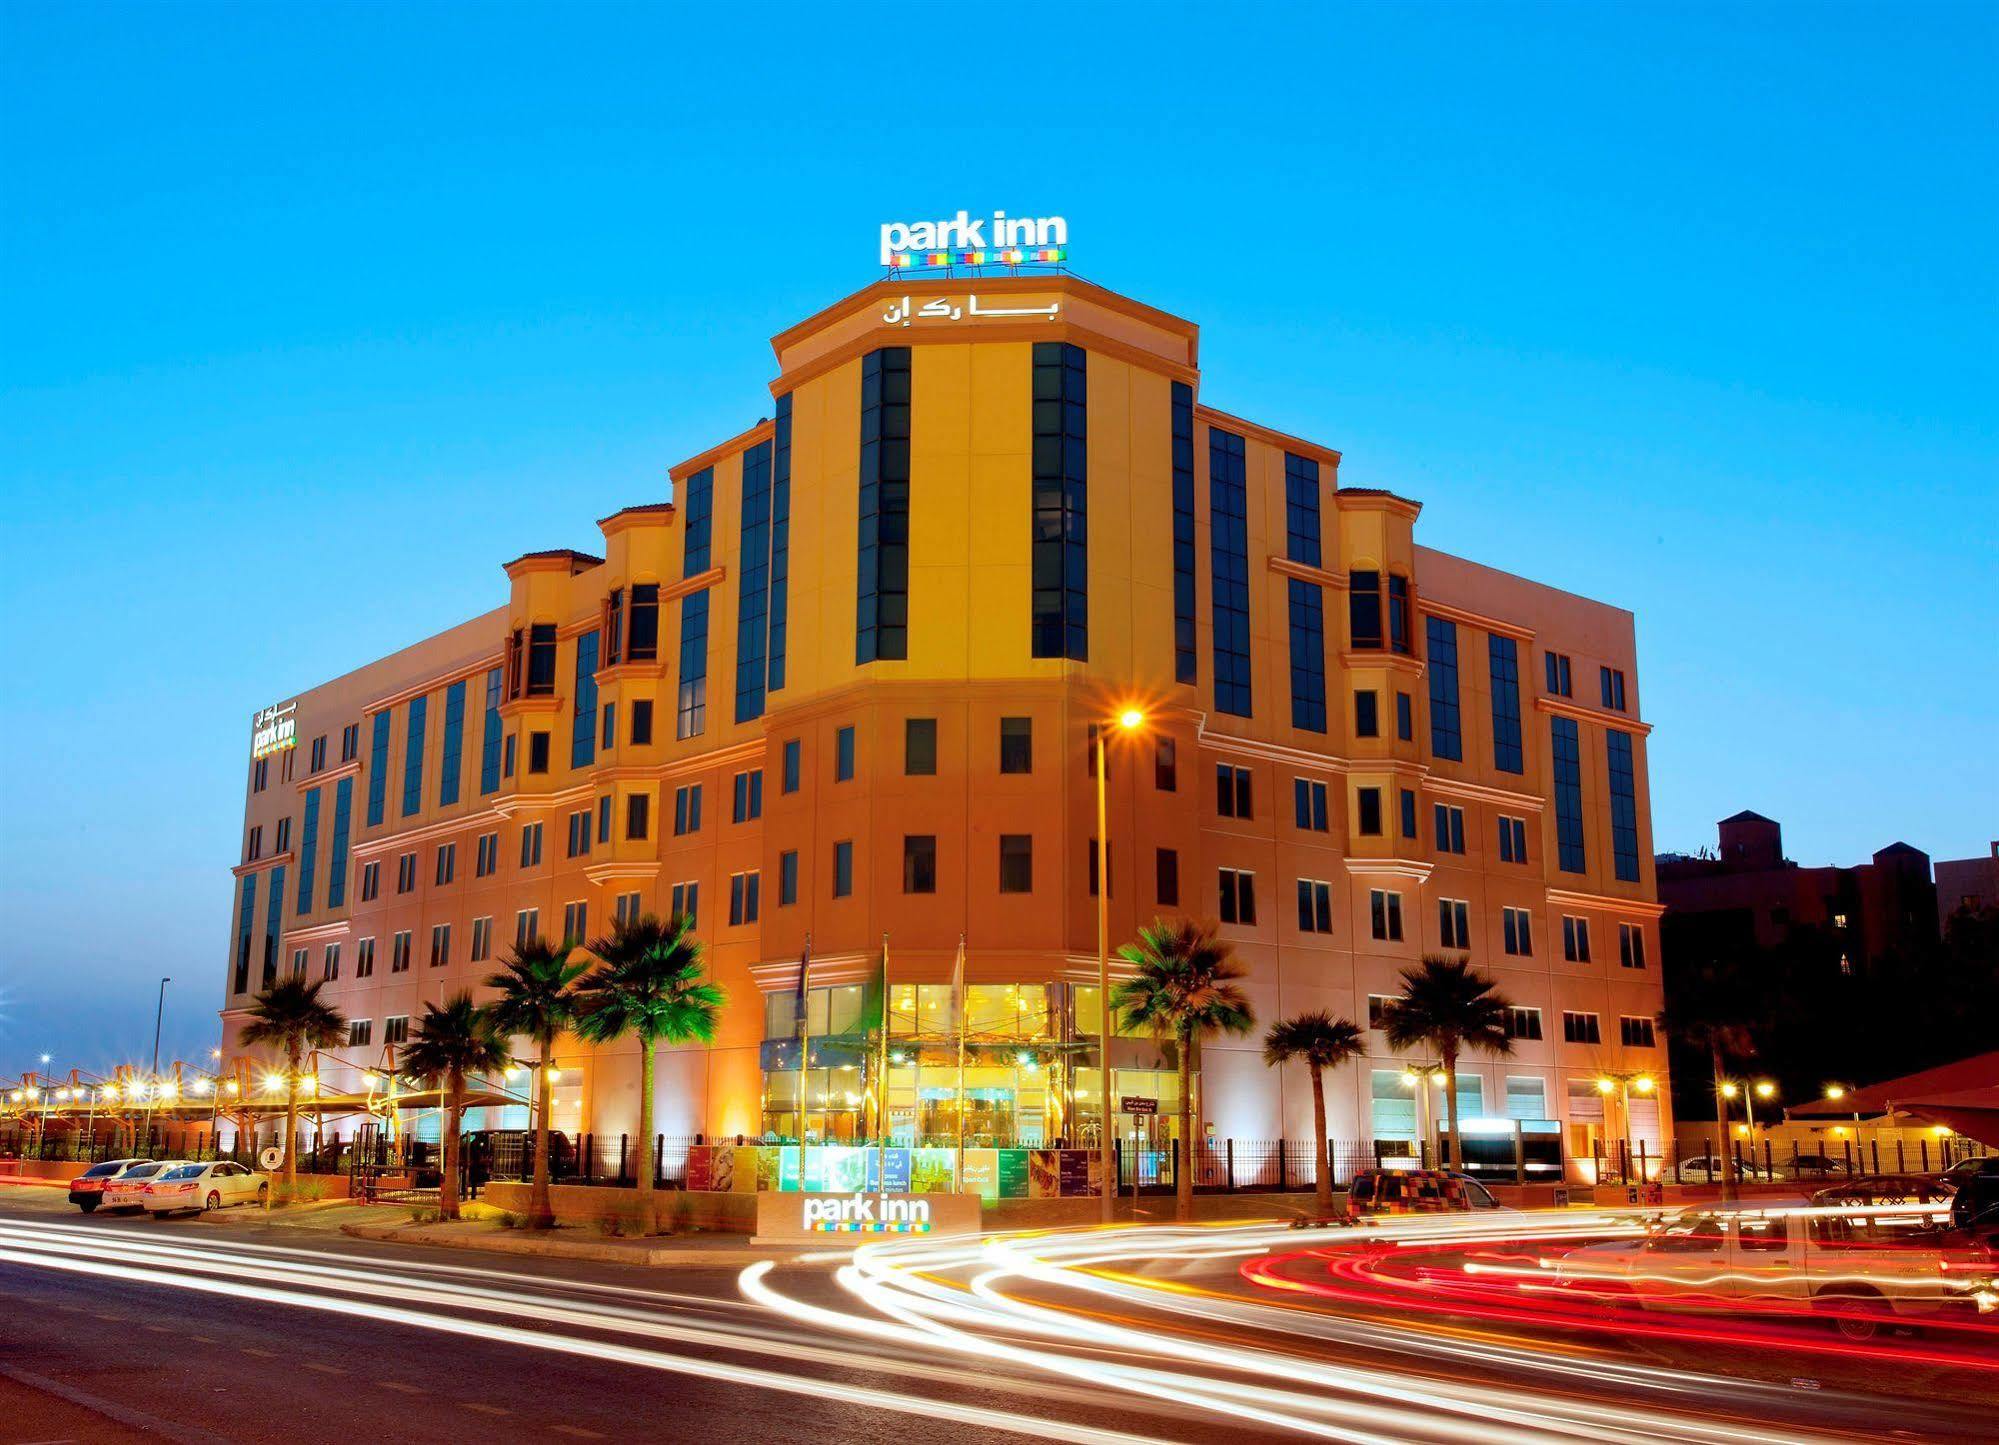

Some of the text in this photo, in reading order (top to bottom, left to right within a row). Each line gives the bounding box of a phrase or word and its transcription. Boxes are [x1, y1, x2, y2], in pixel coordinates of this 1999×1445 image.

[880, 210, 1068, 266] park inn
[253, 717, 296, 759] park inn
[803, 1192, 930, 1231] park inn
